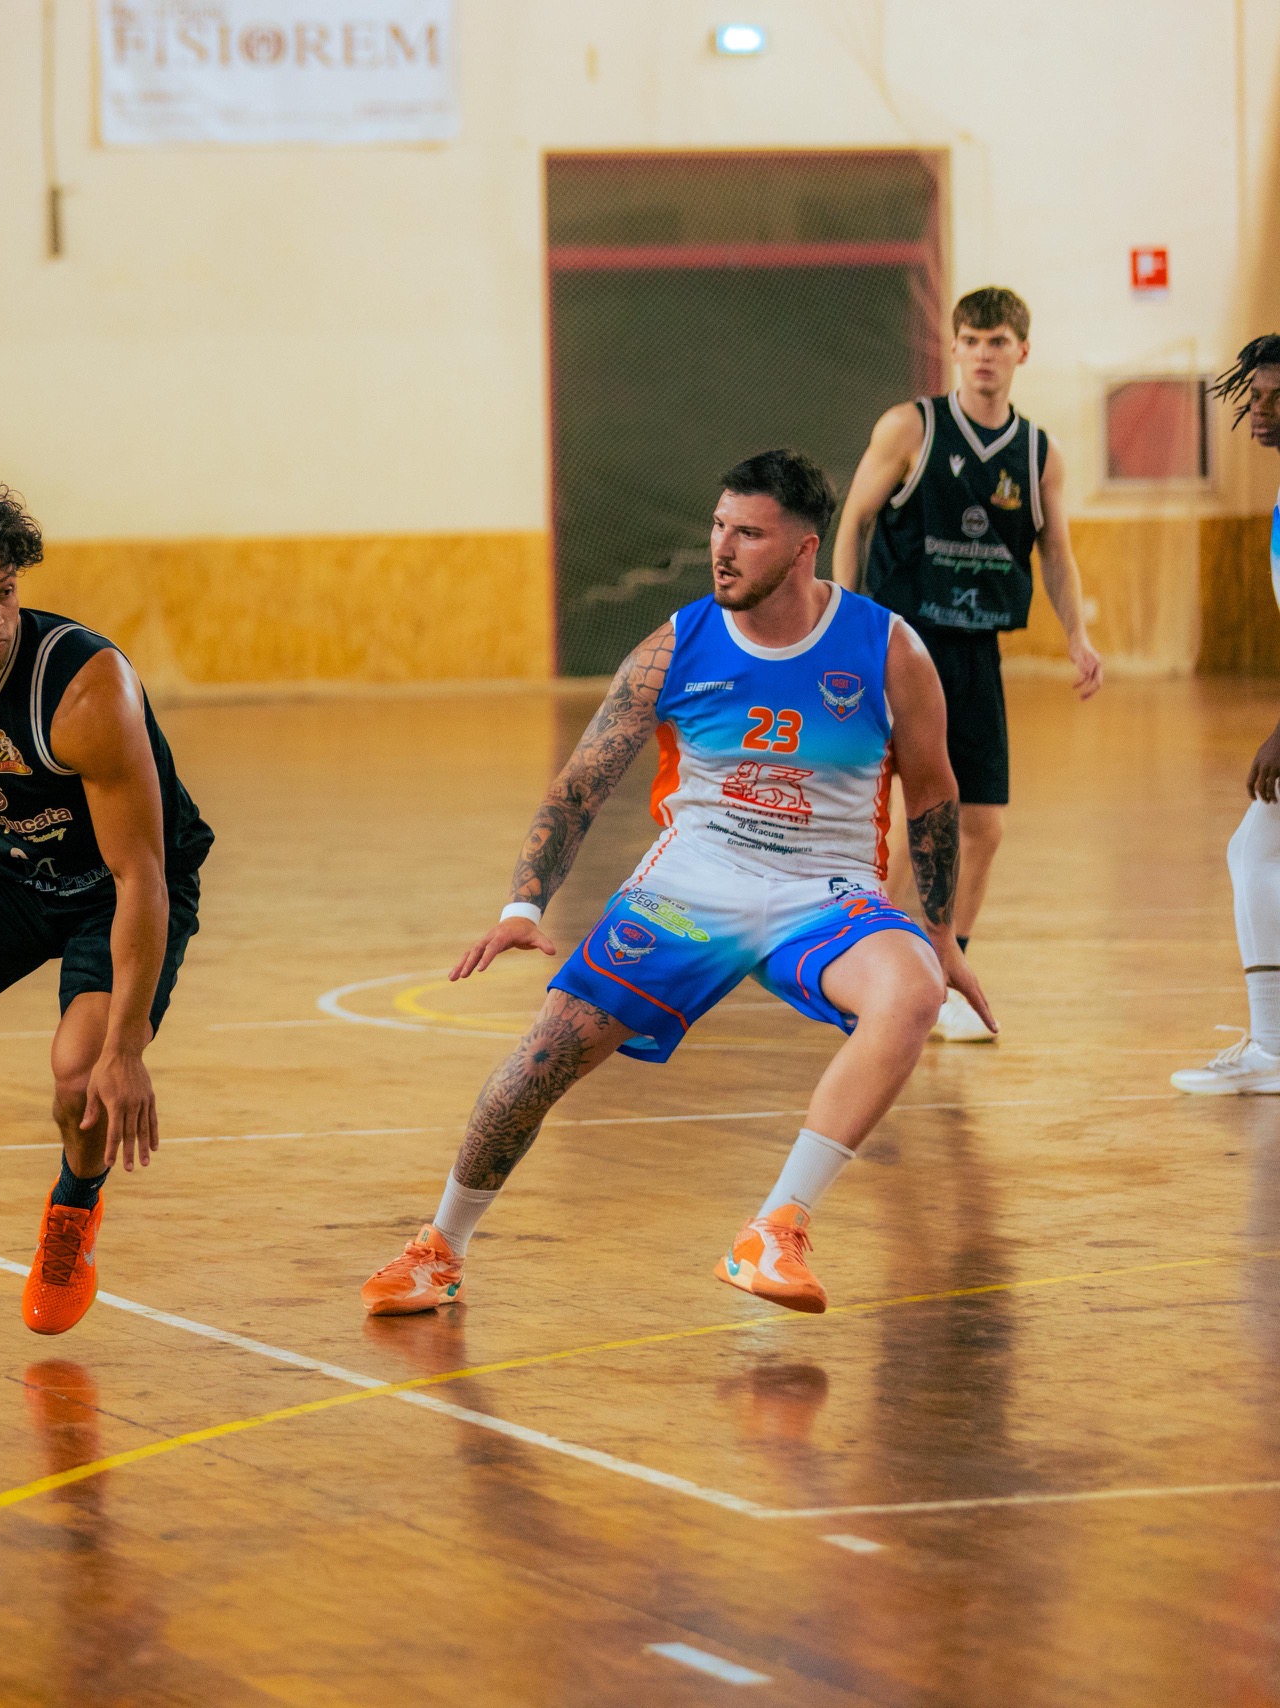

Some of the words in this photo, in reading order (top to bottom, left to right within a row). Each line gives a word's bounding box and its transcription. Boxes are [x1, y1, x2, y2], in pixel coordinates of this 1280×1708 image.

[114, 22, 441, 67] FISIOREM
[684, 681, 735, 692] GIEMME
[742, 706, 803, 754] 23
[737, 822, 746, 830] di
[748, 824, 785, 840] Siracusa
[726, 837, 762, 850] Emanuele
[479, 1106, 497, 1136] MORI
